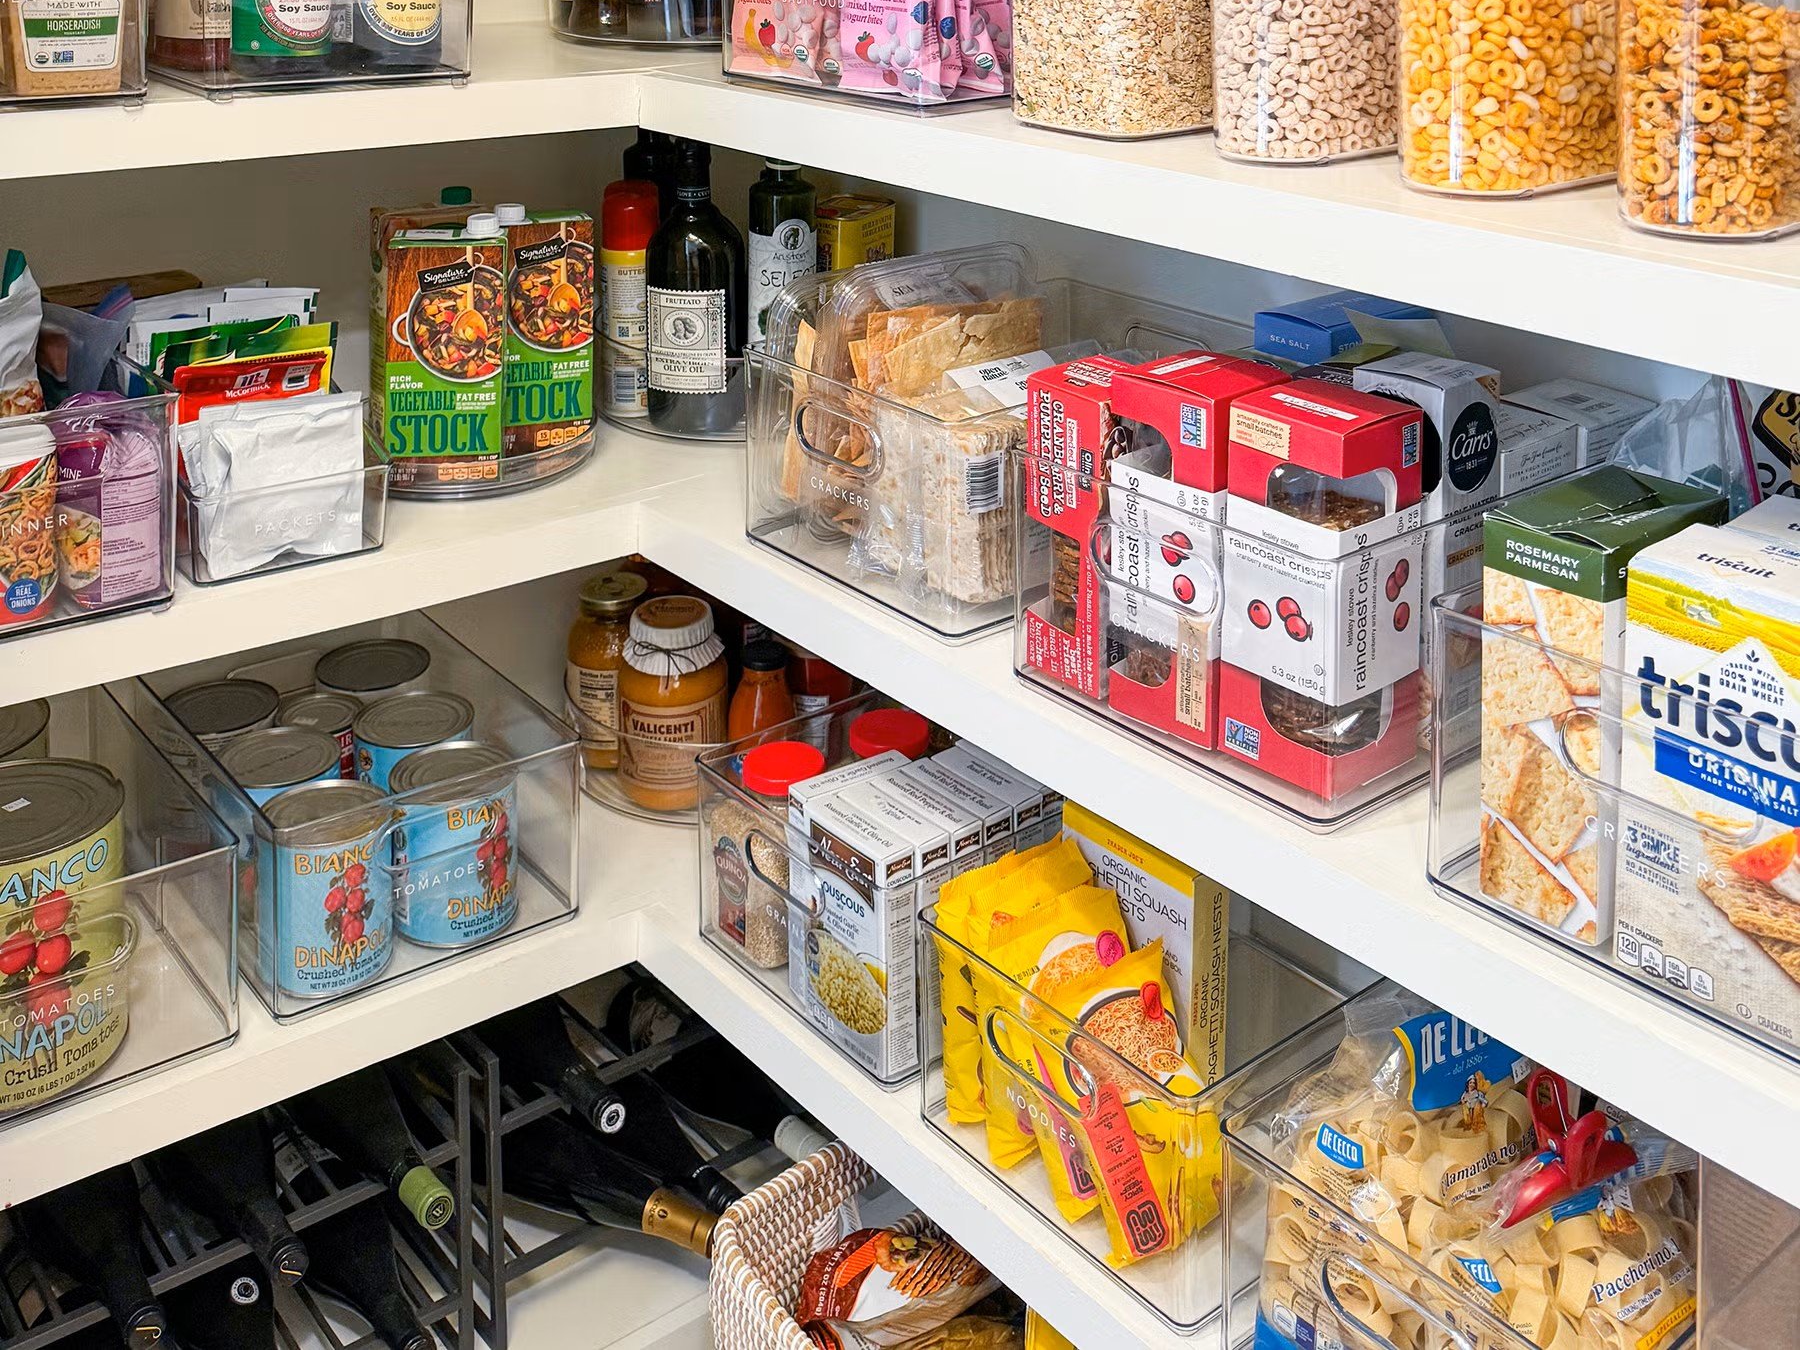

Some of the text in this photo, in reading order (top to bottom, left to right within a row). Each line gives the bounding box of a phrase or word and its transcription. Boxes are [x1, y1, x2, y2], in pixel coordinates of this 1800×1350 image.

[279, 3, 330, 14] Soy Sauce
[386, 1, 437, 11] Soy Sauce
[46, 19, 101, 31] HORSERADISH
[519, 244, 561, 261] Signature
[424, 267, 466, 284] Signature
[665, 296, 702, 306] FRUTTATO
[1269, 334, 1311, 351] SEA SALT
[553, 360, 590, 370] FAT FREE
[655, 358, 680, 367] EXTRA
[663, 364, 705, 374] OLIVE OIL
[979, 366, 1001, 378] open
[225, 382, 272, 399] McCormick
[390, 375, 411, 383] RICH
[390, 382, 423, 390] FLAVOR
[390, 390, 457, 412] VEGETABLE
[456, 392, 497, 402] FAT FREE
[507, 380, 583, 423] TOCK
[1236, 413, 1260, 427] artisanally
[1236, 420, 1283, 441] small batches
[389, 413, 489, 456] STOCK
[1066, 420, 1077, 462] Seeded
[1451, 428, 1494, 460] Carr's
[1465, 459, 1478, 470] 1831
[810, 476, 871, 511] CRACKERS
[255, 510, 337, 536] PACKETS
[1229, 537, 1286, 567] raincoast
[1280, 538, 1300, 550] stowe
[1506, 539, 1581, 569] ROSEMARY
[1505, 551, 1580, 582] PARMESAN
[1696, 551, 1777, 579] triscuit
[11, 598, 36, 609] ONIONS
[15, 586, 32, 598] REAL
[1355, 532, 1374, 692] raincoast crisps
[1035, 621, 1043, 668] batches
[1111, 612, 1201, 663] CRACKERS
[1271, 665, 1296, 683] 5.3 oz
[1719, 667, 1785, 696] 100% WHOLE
[1184, 692, 1193, 717] small
[1719, 677, 1785, 707] GRAIN WHEAT
[631, 719, 695, 735] VALICENTI
[1700, 774, 1749, 797] MADE WITH
[1107, 838, 1128, 856] TRADER
[1584, 815, 1728, 890] CRACKERS
[1625, 843, 1681, 876] Ingredients
[1640, 832, 1681, 864] SIMPLE
[393, 860, 486, 899] TOMATOES
[716, 856, 748, 884] QUINOA
[886, 873, 912, 888] COUSCOUS
[1101, 854, 1148, 889] ORGANIC
[1625, 859, 1680, 891] NO ARTIFICIAL
[450, 910, 495, 931] Crushed
[1133, 887, 1188, 931] SQUASH
[765, 903, 808, 942] GRAINS
[1618, 919, 1664, 949] PER CRACKERS
[1210, 891, 1223, 1011] SQUASH NESTS
[1620, 936, 1637, 954] 120
[297, 943, 389, 981] Crushed Tomatoes
[1200, 972, 1210, 1029] ORGANIC
[1758, 1015, 1794, 1041] CRACKERS
[4, 1017, 122, 1087] Crush Tomatoes
[1420, 1021, 1448, 1074] DE
[13, 1087, 36, 1101] 103 OZ
[1006, 1088, 1076, 1149] NOODLES
[1321, 1129, 1358, 1162] DE CECCO
[1499, 1143, 1521, 1159] no.
[1124, 1187, 1144, 1202] SPICY
[814, 1259, 835, 1317] 7.2 OZ (204g)
[1592, 1252, 1656, 1303] Paccheri
